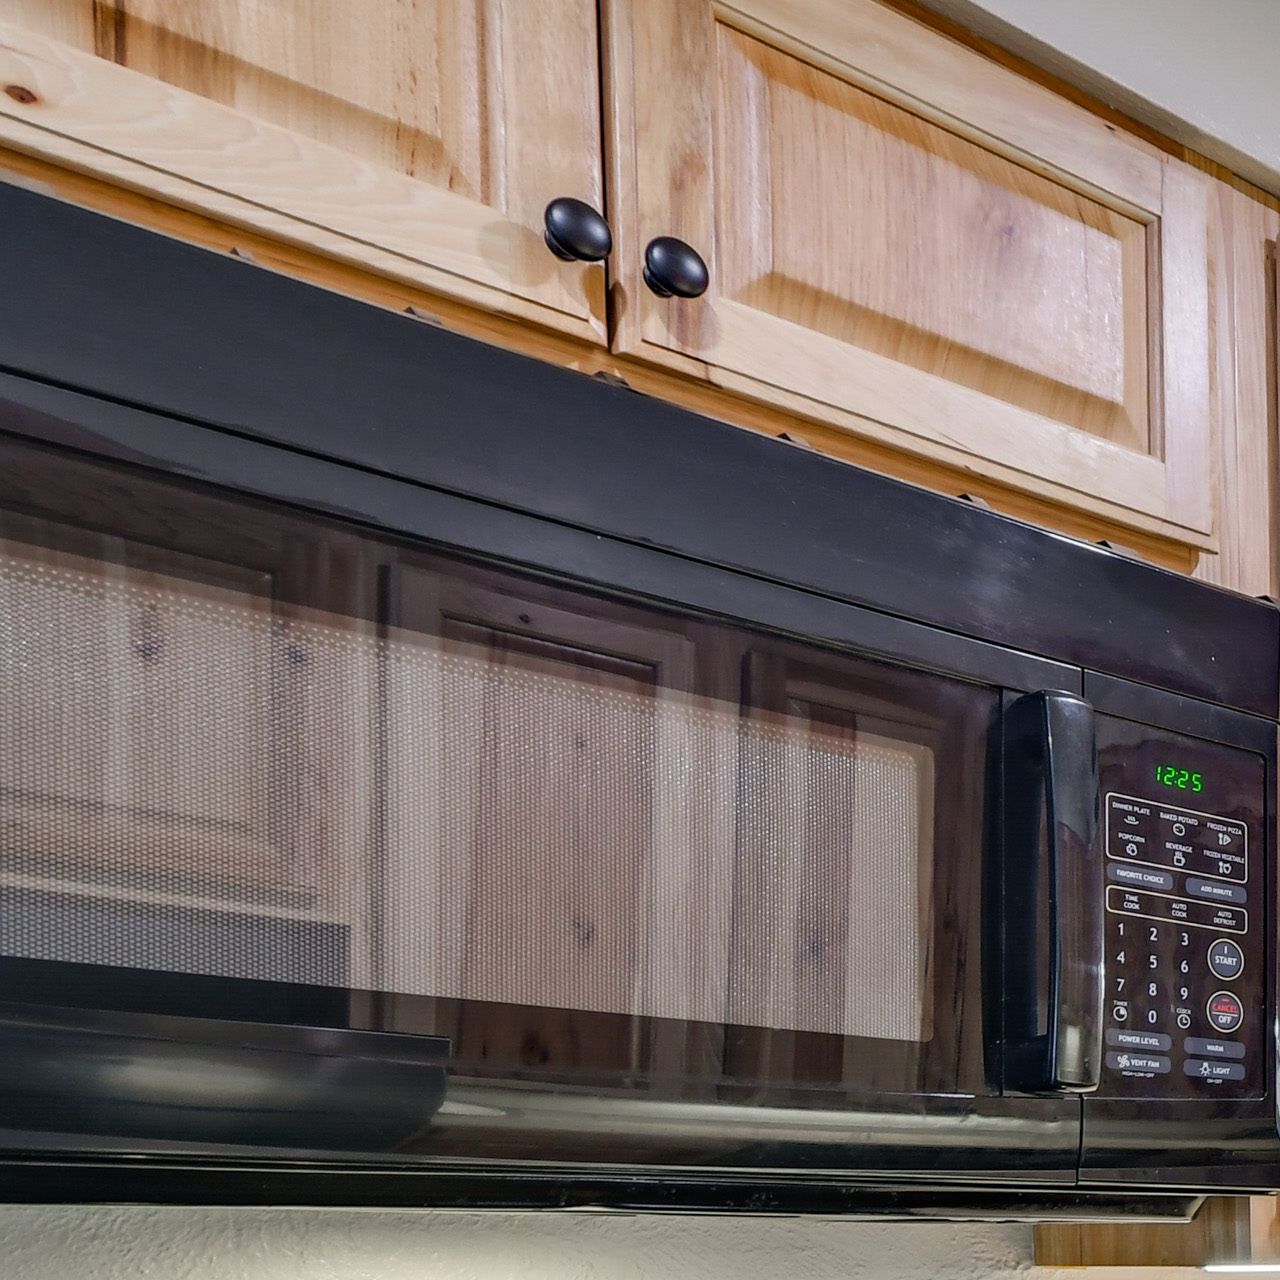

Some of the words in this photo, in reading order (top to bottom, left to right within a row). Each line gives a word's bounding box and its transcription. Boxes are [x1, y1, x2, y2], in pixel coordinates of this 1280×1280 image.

[1156, 765, 1202, 792] 12:25
[1112, 802, 1133, 812] DINNER
[1134, 806, 1150, 816] PLATE
[1160, 812, 1177, 821] BAKED
[1178, 816, 1199, 826] POTATO
[1207, 822, 1227, 832] FROZEN
[1227, 826, 1242, 835] PIZZA
[1118, 832, 1145, 843] POPCORN
[1165, 842, 1193, 853] BEVERAGE
[1203, 850, 1221, 860] FROZEN
[1117, 869, 1142, 880] FAVORITE
[1143, 874, 1164, 884] CHOICE
[1201, 885, 1212, 893] ADD
[1213, 888, 1233, 897] MINUTE
[1125, 894, 1139, 902] TIME
[1123, 901, 1140, 910] COOK
[1171, 903, 1187, 911] AUTO
[1171, 909, 1187, 918] COOK
[1218, 911, 1232, 919] AUTO
[1213, 917, 1237, 927] DEFROST
[1118, 923, 1124, 936] 1
[1149, 927, 1158, 941] 2
[1181, 933, 1189, 946] 3
[1116, 951, 1125, 964] 4
[1149, 955, 1158, 969] 5
[1214, 955, 1238, 966] START
[1180, 960, 1189, 973] 6
[1116, 978, 1125, 992] 7
[1148, 983, 1157, 996] 8
[1180, 987, 1188, 1000] 9
[1212, 1003, 1238, 1013] CANCEL
[1148, 1010, 1157, 1024] 0
[1218, 1015, 1232, 1024] OFF
[1118, 1034, 1140, 1044] POWER
[1141, 1037, 1160, 1046] LEVEL
[1130, 1058, 1147, 1067] VENT
[1148, 1060, 1160, 1068] FAN
[1213, 1067, 1231, 1075] LIGHT
